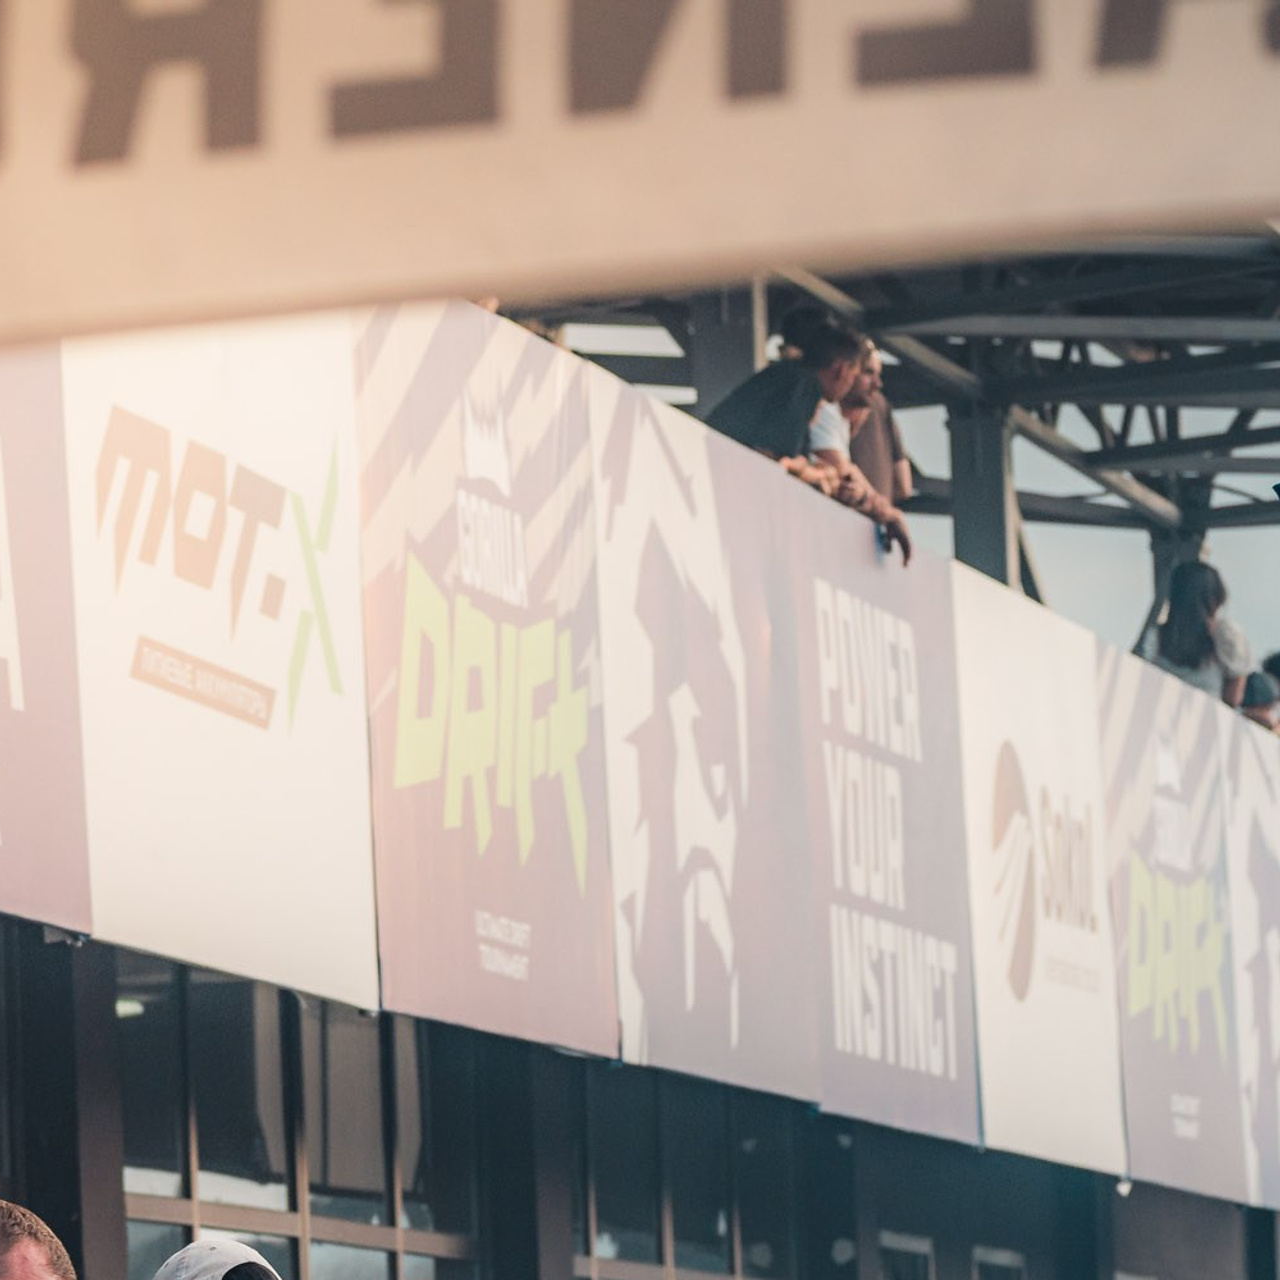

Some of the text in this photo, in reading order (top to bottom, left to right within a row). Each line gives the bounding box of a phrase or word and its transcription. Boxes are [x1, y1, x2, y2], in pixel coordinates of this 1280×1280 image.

[394, 550, 589, 895] DRIFT
[814, 577, 922, 762] POWER
[822, 740, 905, 911] YOUR
[829, 903, 958, 1081] INSTINCT
